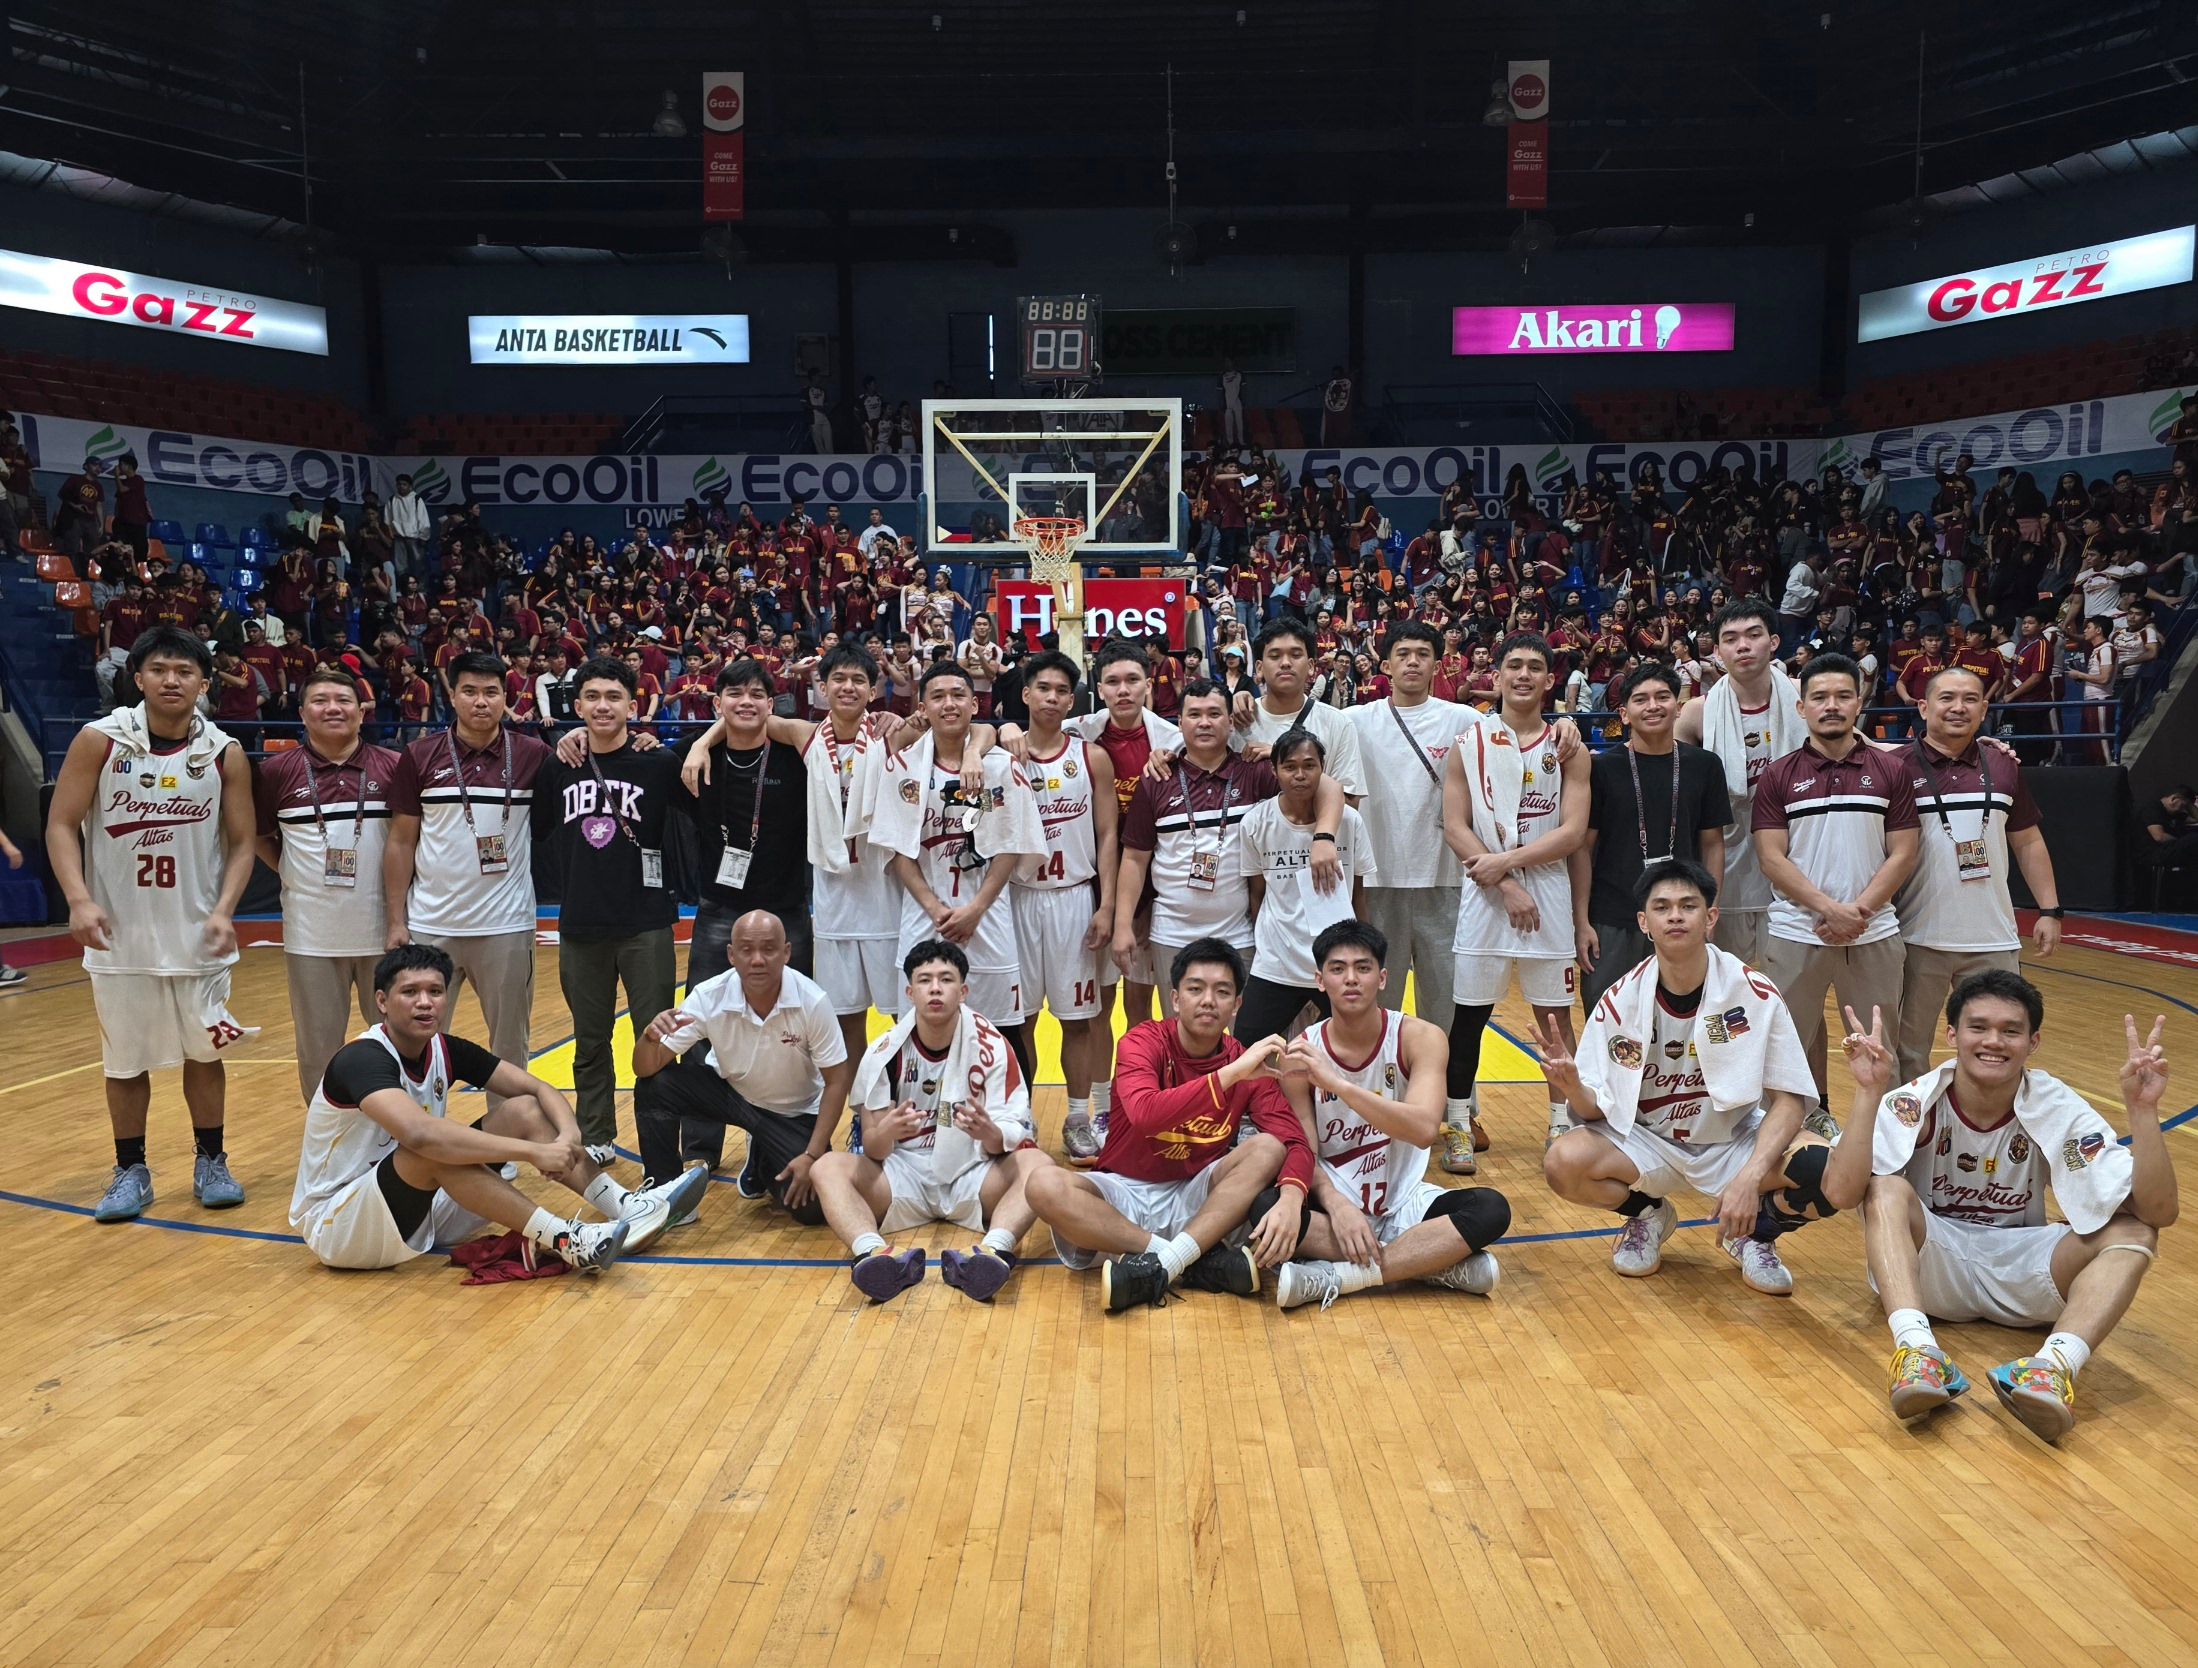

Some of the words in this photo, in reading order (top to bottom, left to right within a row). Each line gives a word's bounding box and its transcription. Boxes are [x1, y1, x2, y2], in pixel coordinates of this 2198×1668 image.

[709, 98, 737, 109] Gazz
[1514, 87, 1543, 97] Gazz
[710, 161, 737, 171] Gazz
[1514, 149, 1543, 159] Gazz
[2035, 249, 2110, 274] PETRO
[72, 272, 257, 339] Gazz
[187, 289, 257, 310] PETRO
[1927, 262, 2109, 322] Gazz
[495, 328, 547, 352] ANTA
[554, 328, 683, 352] BASKETBALL
[1508, 308, 1644, 349] Akari
[1871, 401, 2104, 480] EcoOil
[147, 431, 372, 504] EcoOil
[461, 455, 658, 504] EcoOil
[742, 455, 922, 503] EcoOi
[1302, 447, 1500, 496] EcoOil
[1006, 594, 1167, 638] Hnes
[112, 760, 131, 774] 100
[104, 790, 213, 822] Perpetual
[563, 779, 645, 824] DBTK
[1038, 793, 1088, 816] petual
[1520, 790, 1557, 812] etual
[131, 828, 174, 850] Altas
[137, 854, 176, 888] 28
[1276, 855, 1309, 867] ALT
[950, 867, 960, 897] 7
[1074, 979, 1096, 1007] 14
[1565, 967, 1575, 994] 9
[1011, 984, 1019, 1012] 7
[206, 1020, 244, 1050] 28
[1704, 1013, 1725, 1045] NCAA
[1723, 1006, 1750, 1040] 100
[905, 1069, 918, 1084] 100
[1659, 1102, 1702, 1125] Altas
[1320, 1118, 1383, 1145] Perpe
[1352, 1151, 1386, 1180] Altas
[2063, 1138, 2084, 1172] NCAA
[1360, 1181, 1389, 1217] 12
